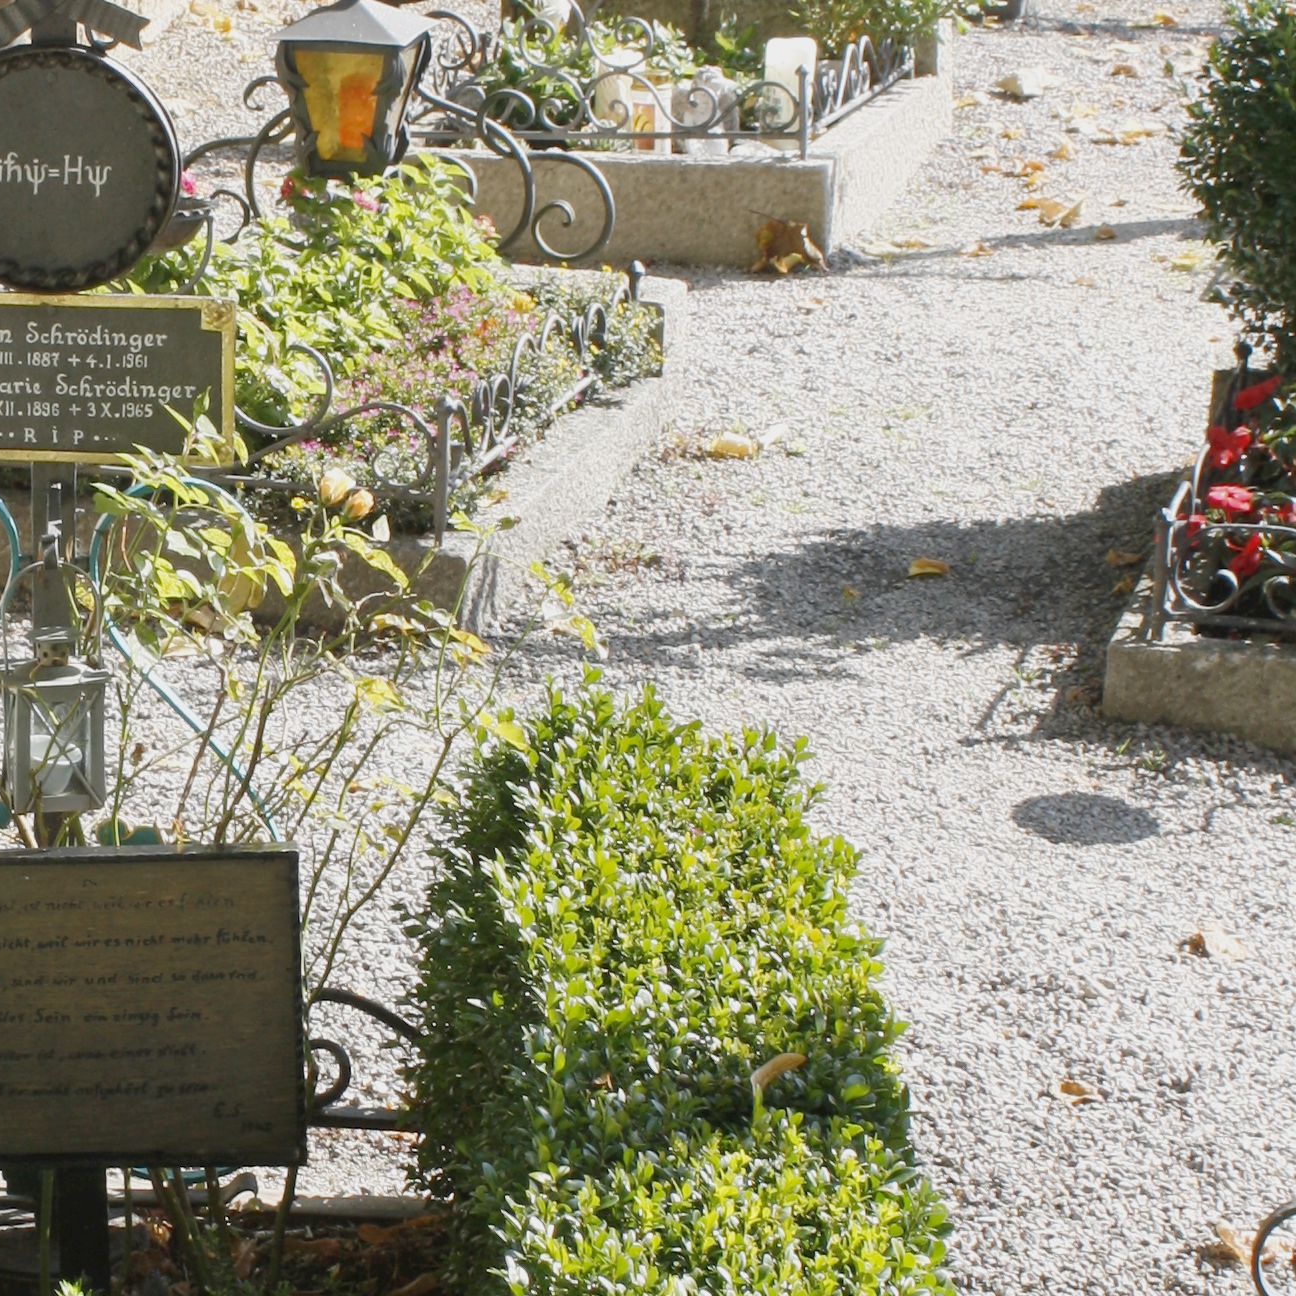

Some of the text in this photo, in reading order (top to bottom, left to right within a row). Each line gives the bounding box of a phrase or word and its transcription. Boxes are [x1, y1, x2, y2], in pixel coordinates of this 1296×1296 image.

[26, 321, 167, 353] Schrödinger
[55, 373, 196, 404] Schrödinger
[85, 973, 117, 985] und
[34, 1007, 71, 1023] Sein
